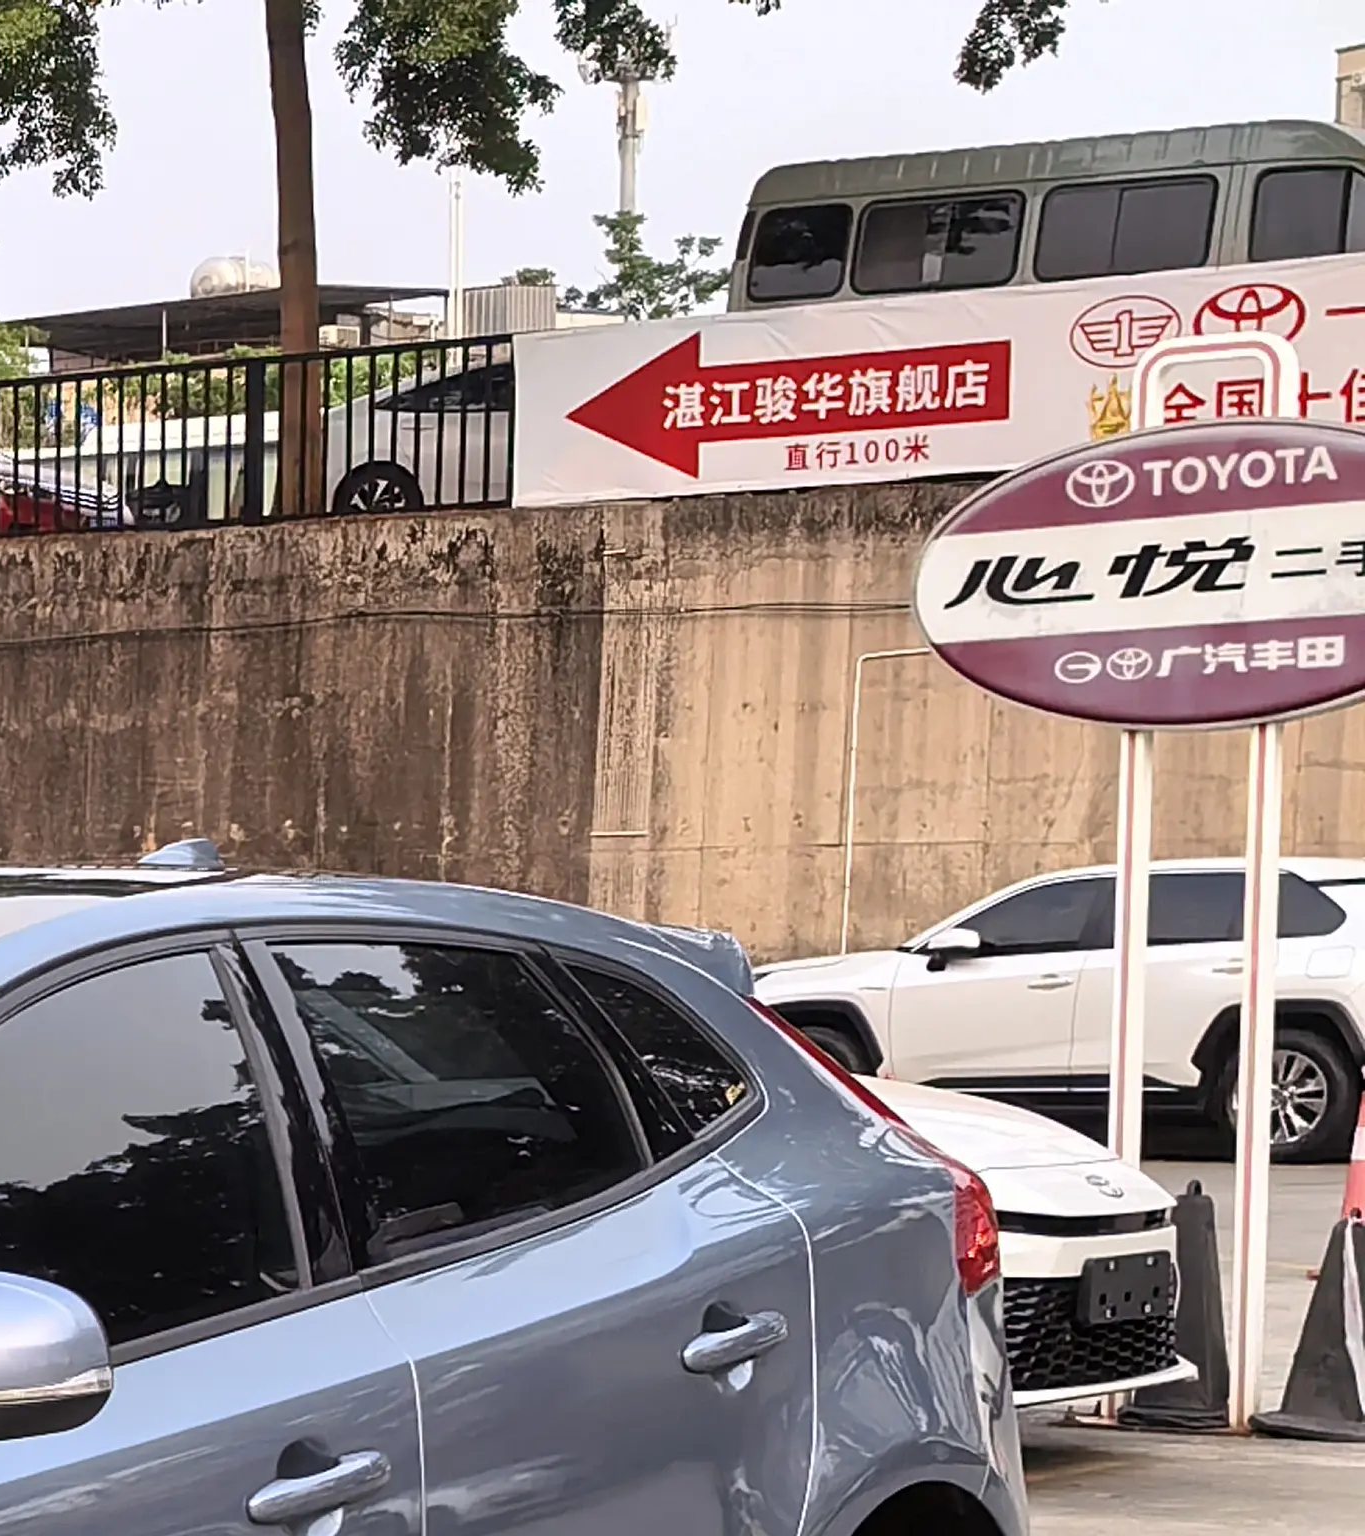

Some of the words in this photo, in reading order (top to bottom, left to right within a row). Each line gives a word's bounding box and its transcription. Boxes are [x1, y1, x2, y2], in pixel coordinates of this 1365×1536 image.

[662, 359, 991, 430] 湛江骏华旗舰店
[784, 434, 931, 471] 直行100米
[1142, 445, 1338, 497] TOYOTA
[1156, 635, 1345, 679] 广汽丰田
